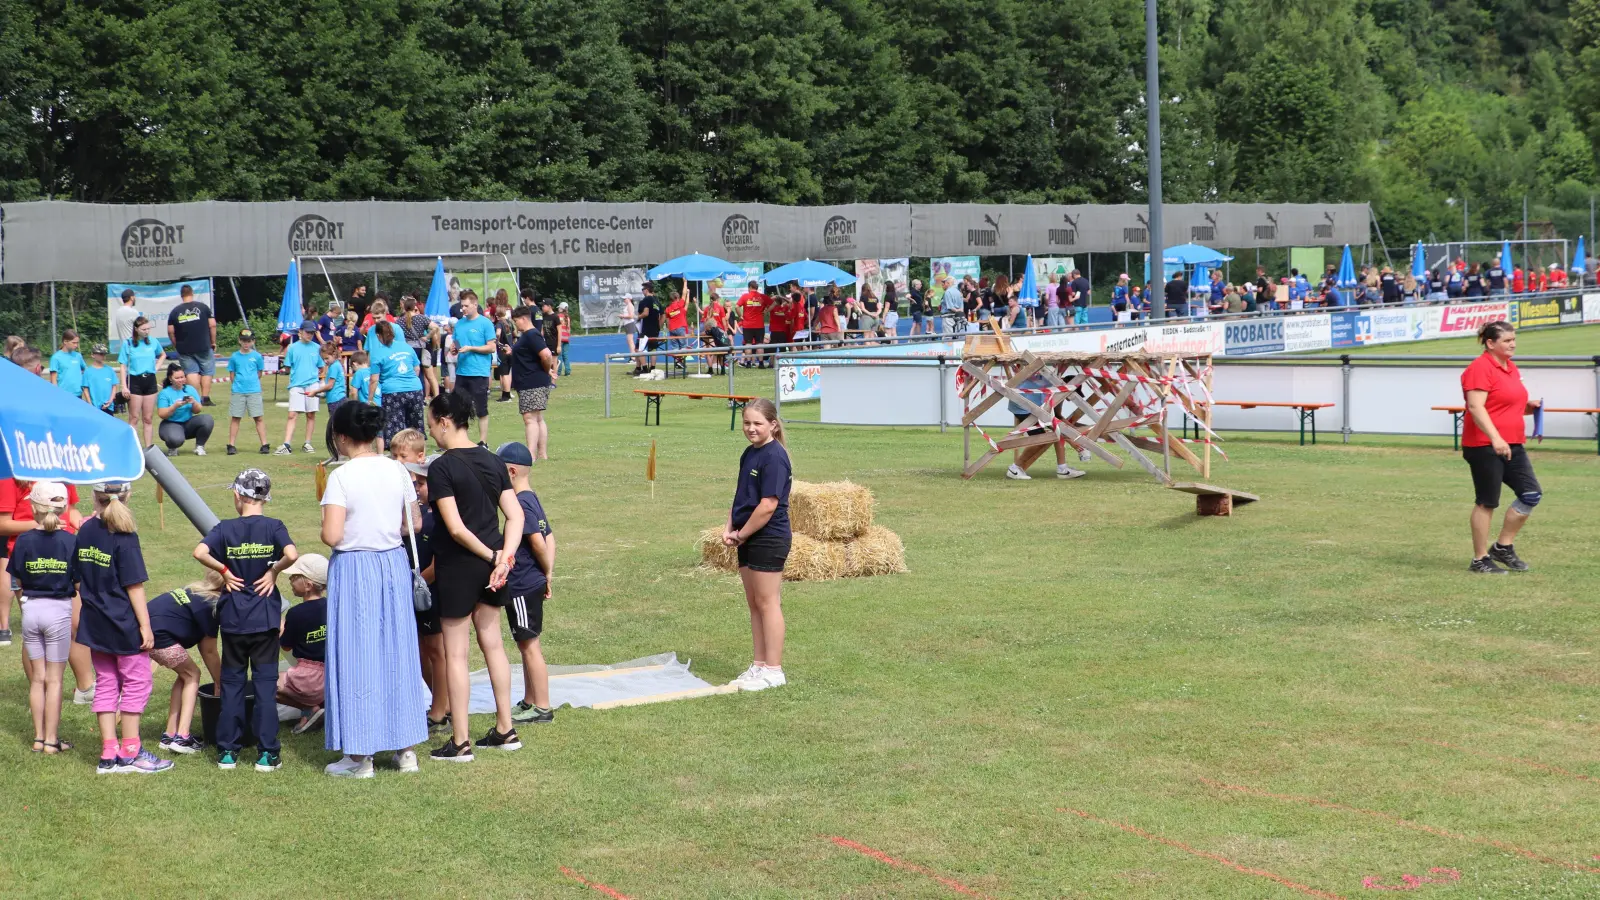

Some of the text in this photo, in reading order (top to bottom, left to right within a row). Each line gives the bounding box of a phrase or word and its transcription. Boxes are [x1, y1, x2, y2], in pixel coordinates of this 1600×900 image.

[296, 221, 344, 239] SPORT
[432, 214, 654, 234] Teamsport-Competence-Center
[727, 220, 760, 234] SPORT
[828, 220, 857, 235] SPORT
[129, 225, 185, 245] SPORT
[968, 229, 997, 246] PUMA
[1048, 229, 1075, 245] PUMA
[1123, 228, 1147, 243] PUMA
[1192, 226, 1214, 240] PUMA
[127, 244, 174, 259] BÜCHERL
[293, 237, 334, 252] BÜCHERL
[460, 238, 632, 255] Partner des 1.FC Rieden
[1439, 306, 1507, 332] LEHNER
[1162, 327, 1179, 335] RIEDEN
[1225, 321, 1284, 344] PROBATEC
